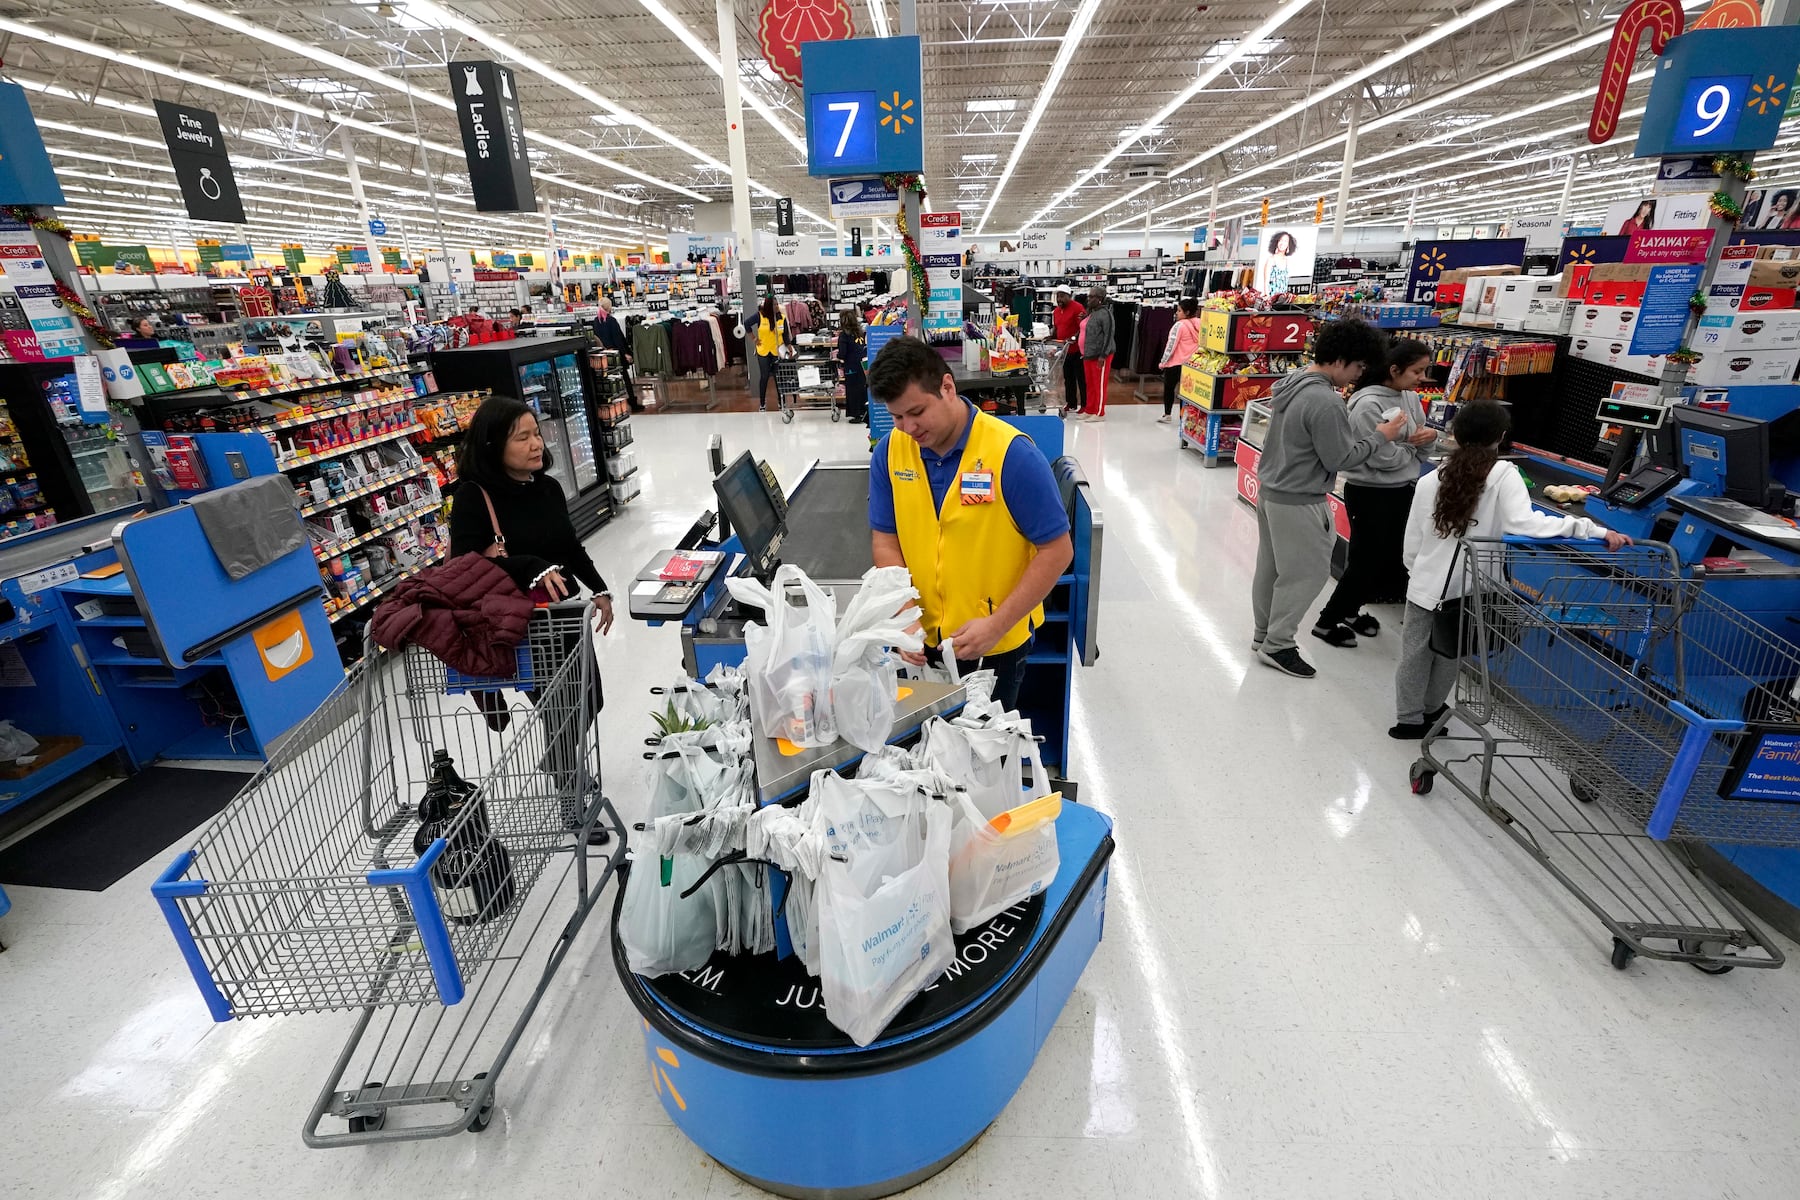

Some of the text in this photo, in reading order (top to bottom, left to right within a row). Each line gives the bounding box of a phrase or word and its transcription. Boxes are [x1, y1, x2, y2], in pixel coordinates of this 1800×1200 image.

[1693, 84, 1732, 137] 9
[178, 113, 203, 129] Fine
[470, 103, 490, 159] Ladies
[506, 105, 521, 160] Ladies
[829, 102, 859, 157] 7
[176, 127, 213, 148] Jewelry
[928, 216, 948, 224] Credit
[1673, 210, 1698, 221] Fitting
[1515, 219, 1552, 229] Seasonal
[1022, 232, 1048, 241] Ladies'
[776, 239, 801, 249] Ladies'
[1640, 237, 1691, 248] LAYAWAY
[3, 246, 29, 256] Credit
[117, 250, 147, 262] Grocery
[776, 248, 796, 256] Wear
[1637, 249, 1650, 258] Pay
[1657, 250, 1670, 258] any
[1670, 248, 1692, 258] registe
[1727, 248, 1747, 256] Credit
[929, 257, 955, 267] Protect
[23, 286, 53, 295] Protect
[1413, 288, 1438, 302] Lo
[1247, 331, 1266, 341] Doritos
[1283, 322, 1300, 344] 2
[1705, 333, 1719, 343] $79
[1210, 420, 1220, 451] Live better.
[1764, 739, 1793, 748] Walmart
[1748, 772, 1763, 780] The
[1763, 773, 1781, 781] Best
[866, 814, 885, 826] Pay
[861, 916, 905, 953] Walmart
[945, 916, 1015, 982] MORE
[871, 952, 887, 967] Pay
